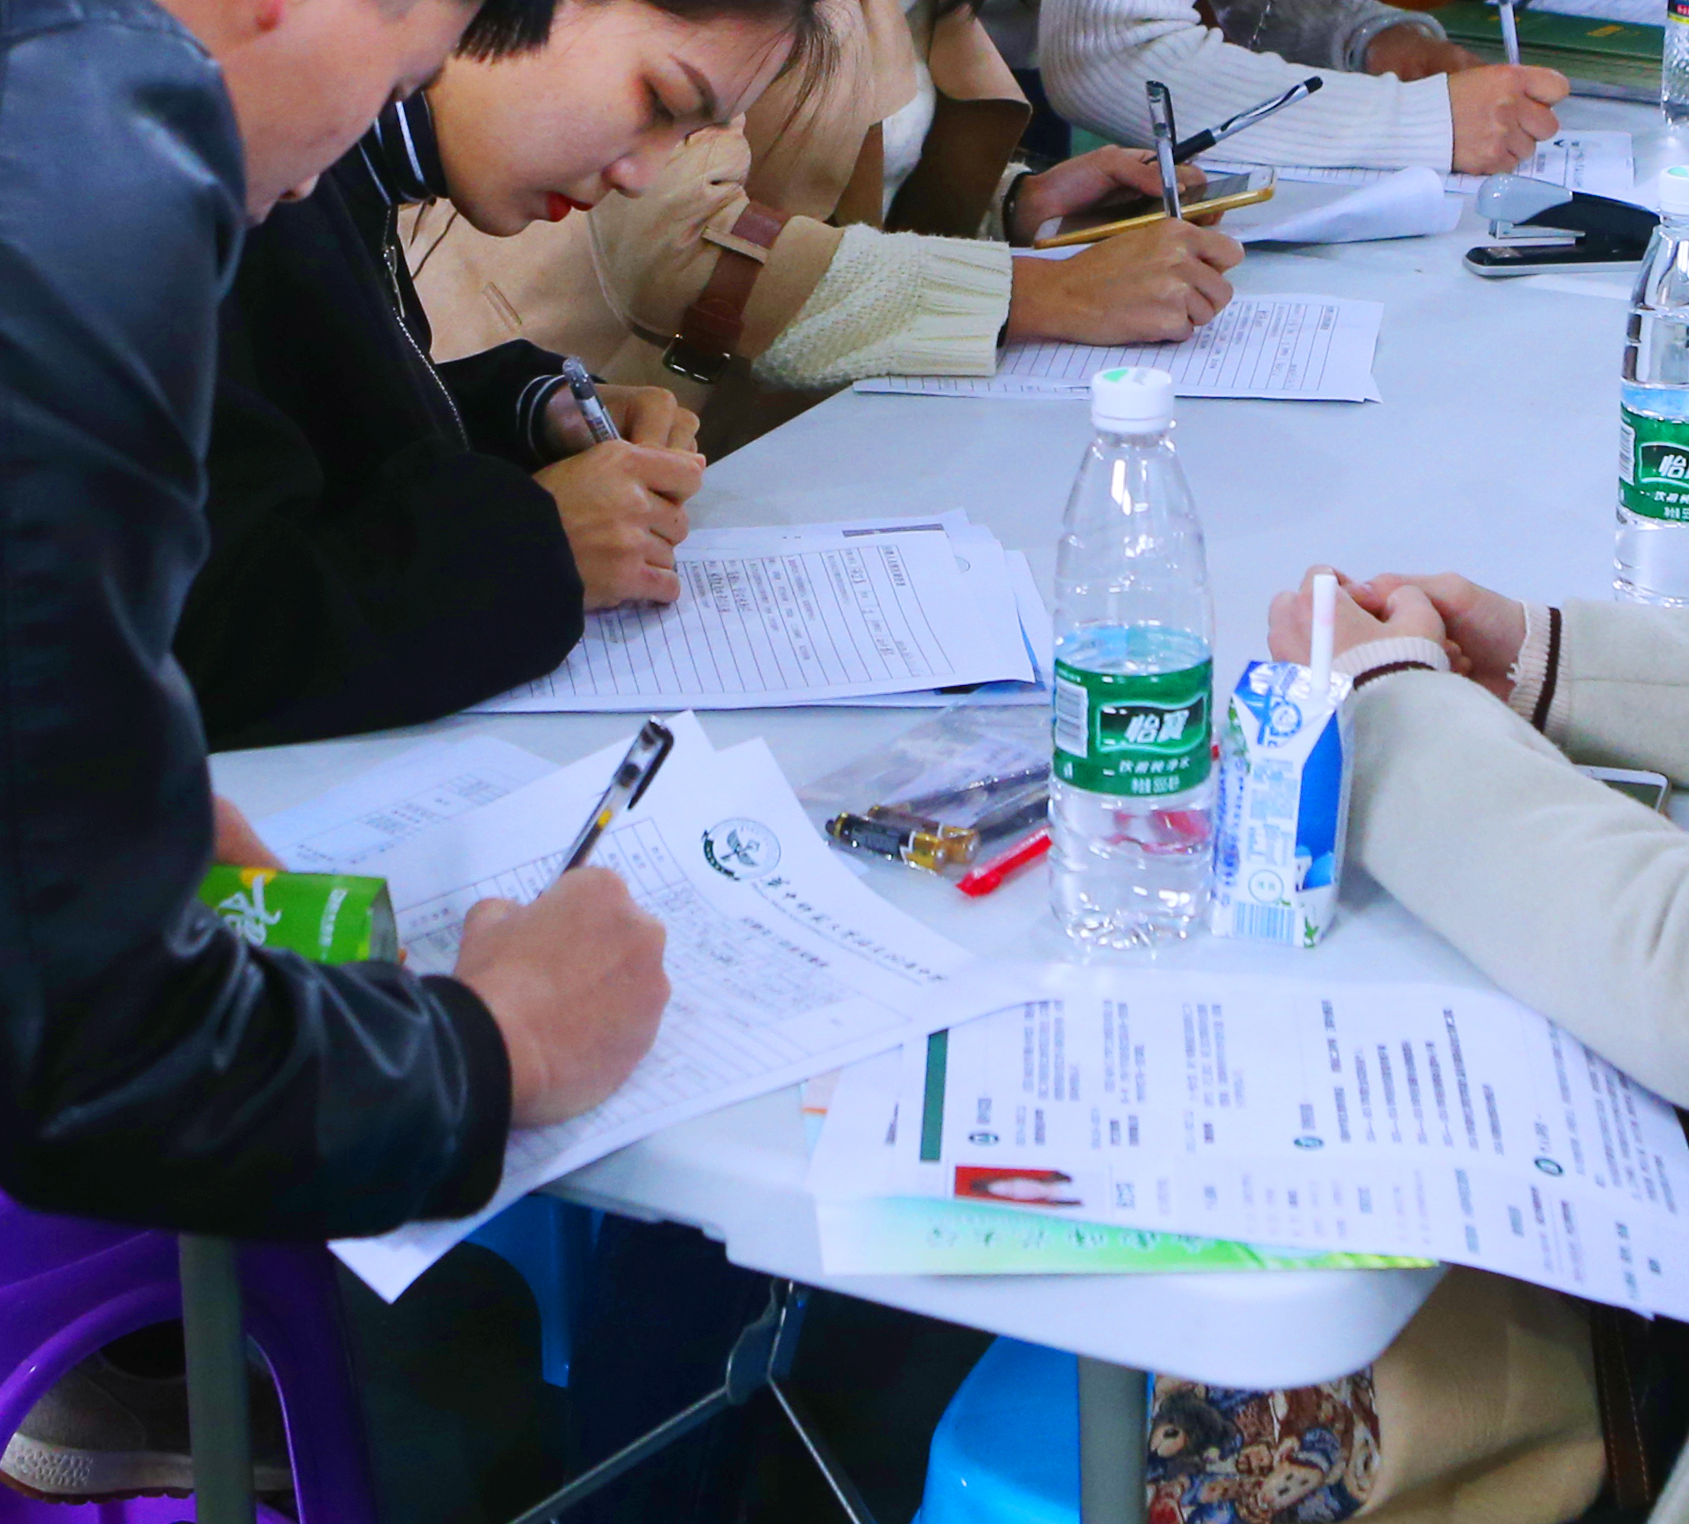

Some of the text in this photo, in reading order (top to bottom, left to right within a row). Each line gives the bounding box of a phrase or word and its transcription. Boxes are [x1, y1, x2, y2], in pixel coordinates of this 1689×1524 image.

[1119, 755, 1191, 774] 饮用纯净水
